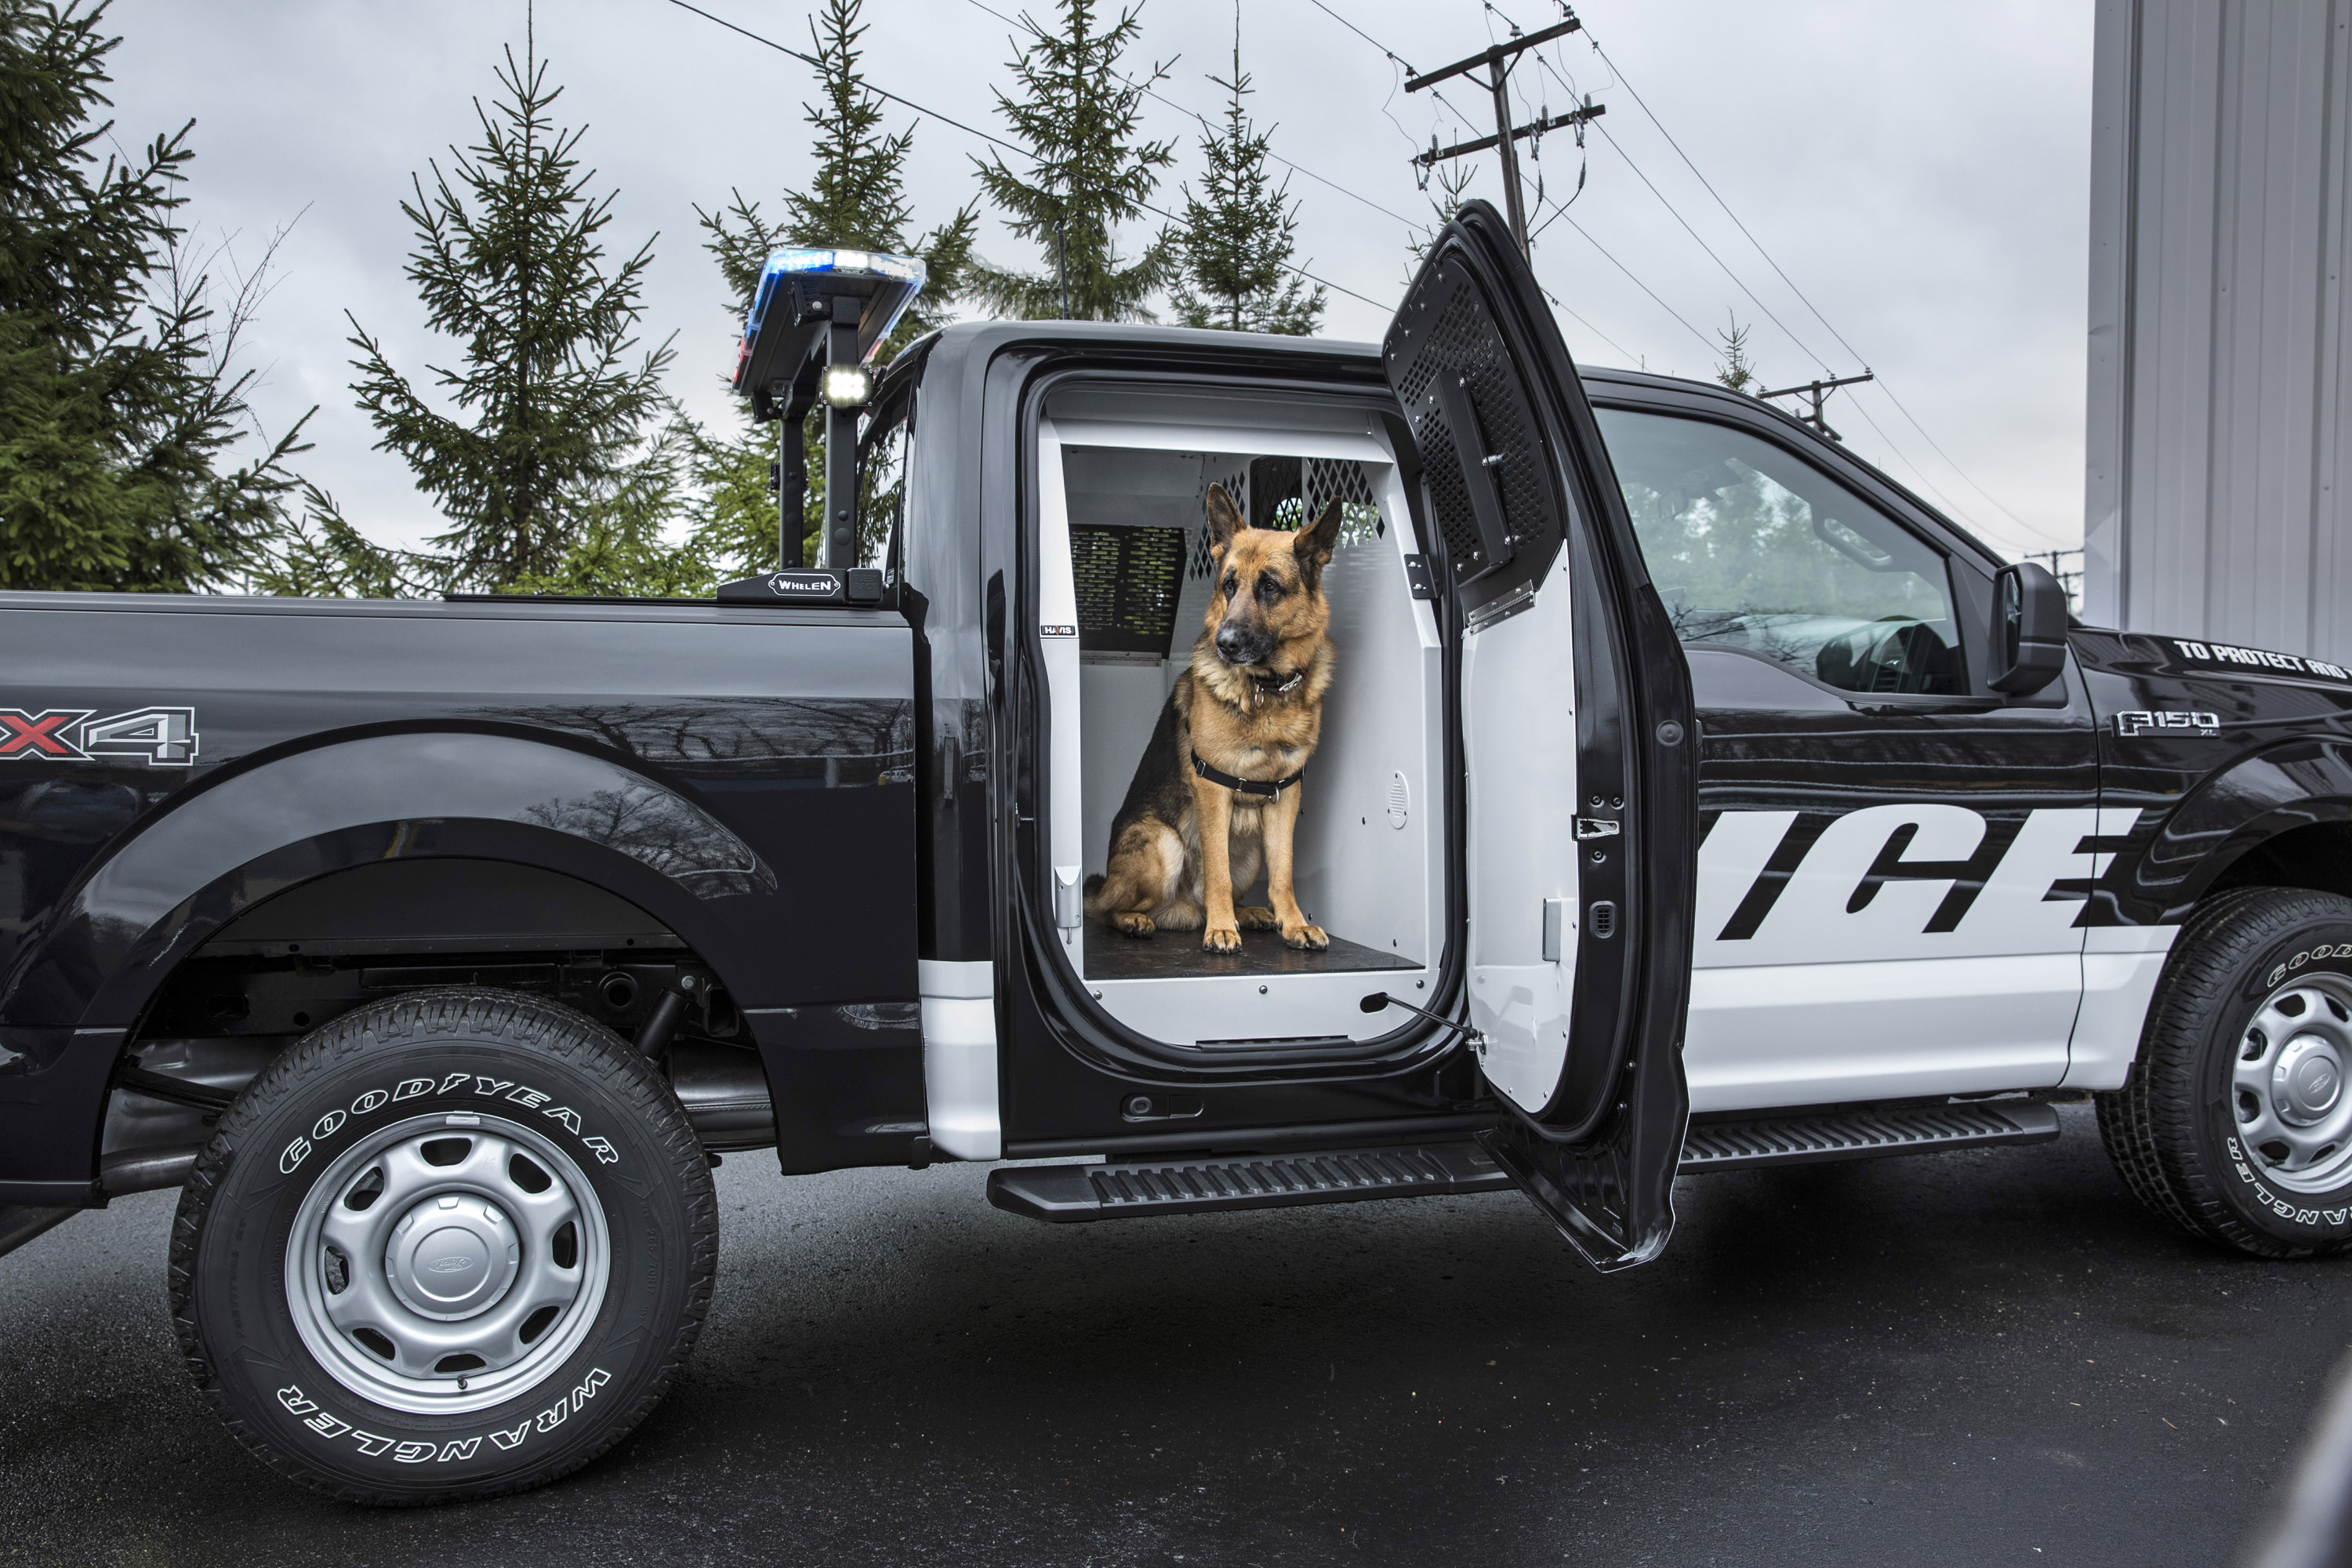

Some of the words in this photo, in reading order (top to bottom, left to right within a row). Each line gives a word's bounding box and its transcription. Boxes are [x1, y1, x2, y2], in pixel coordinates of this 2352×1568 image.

[779, 579, 831, 590] WHELEN
[1044, 626, 1072, 635] HAVIS
[2173, 641, 2211, 660] TO
[2210, 644, 2305, 671] PROTECT
[2304, 659, 2347, 679] AND
[0, 707, 199, 766] X4
[1697, 804, 2143, 941] ICE
[2267, 944, 2352, 988] GOOD
[279, 1073, 619, 1174] GOODYEAR
[2227, 1138, 2352, 1225] ANGLER
[277, 1367, 612, 1463] WRANGLER
